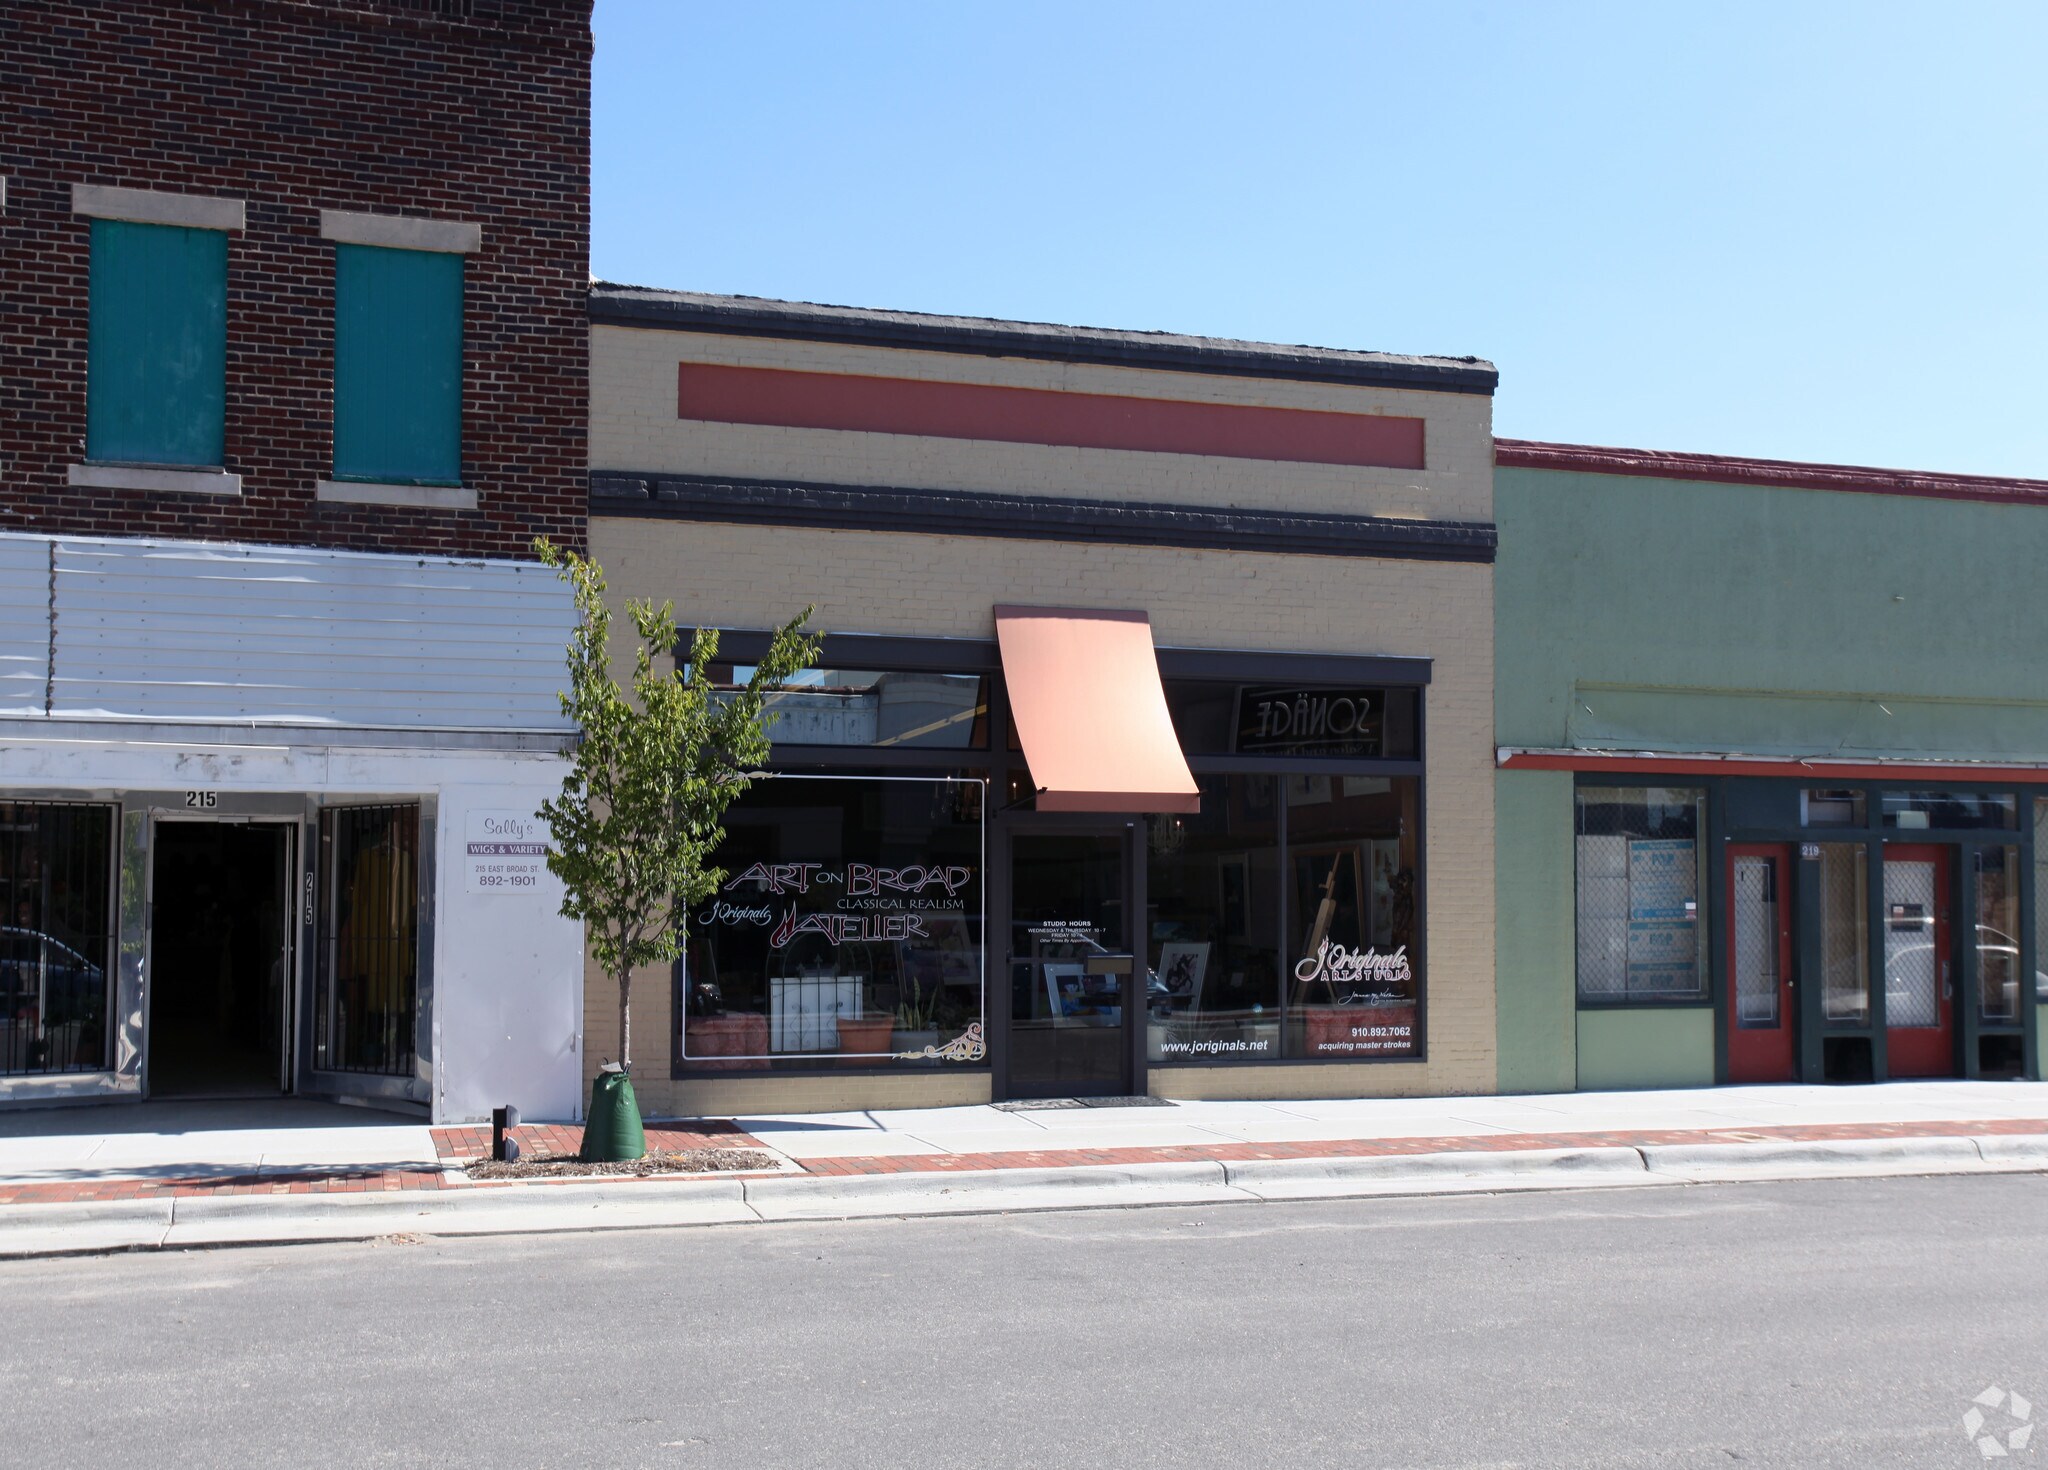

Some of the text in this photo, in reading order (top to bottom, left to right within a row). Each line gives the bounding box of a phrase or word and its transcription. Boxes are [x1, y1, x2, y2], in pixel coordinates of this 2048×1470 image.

[186, 791, 216, 807] 215
[484, 817, 533, 840] Sally's
[470, 845, 546, 854] WIGS & VARIETY
[475, 865, 540, 873] 215 EAST BROAD ST.
[479, 875, 536, 886] 892-1901
[724, 862, 970, 896] ART ON BROAD
[306, 872, 314, 925] 215
[836, 898, 964, 910] CLASSICAL REALISM
[779, 914, 930, 945] ATELIER
[1320, 970, 1411, 981] ART STUDIO
[1351, 1027, 1411, 1037] 910.892.7062
[1160, 1039, 1268, 1055] www.joriginals.net
[1318, 1040, 1411, 1052] acquiring master strokes
